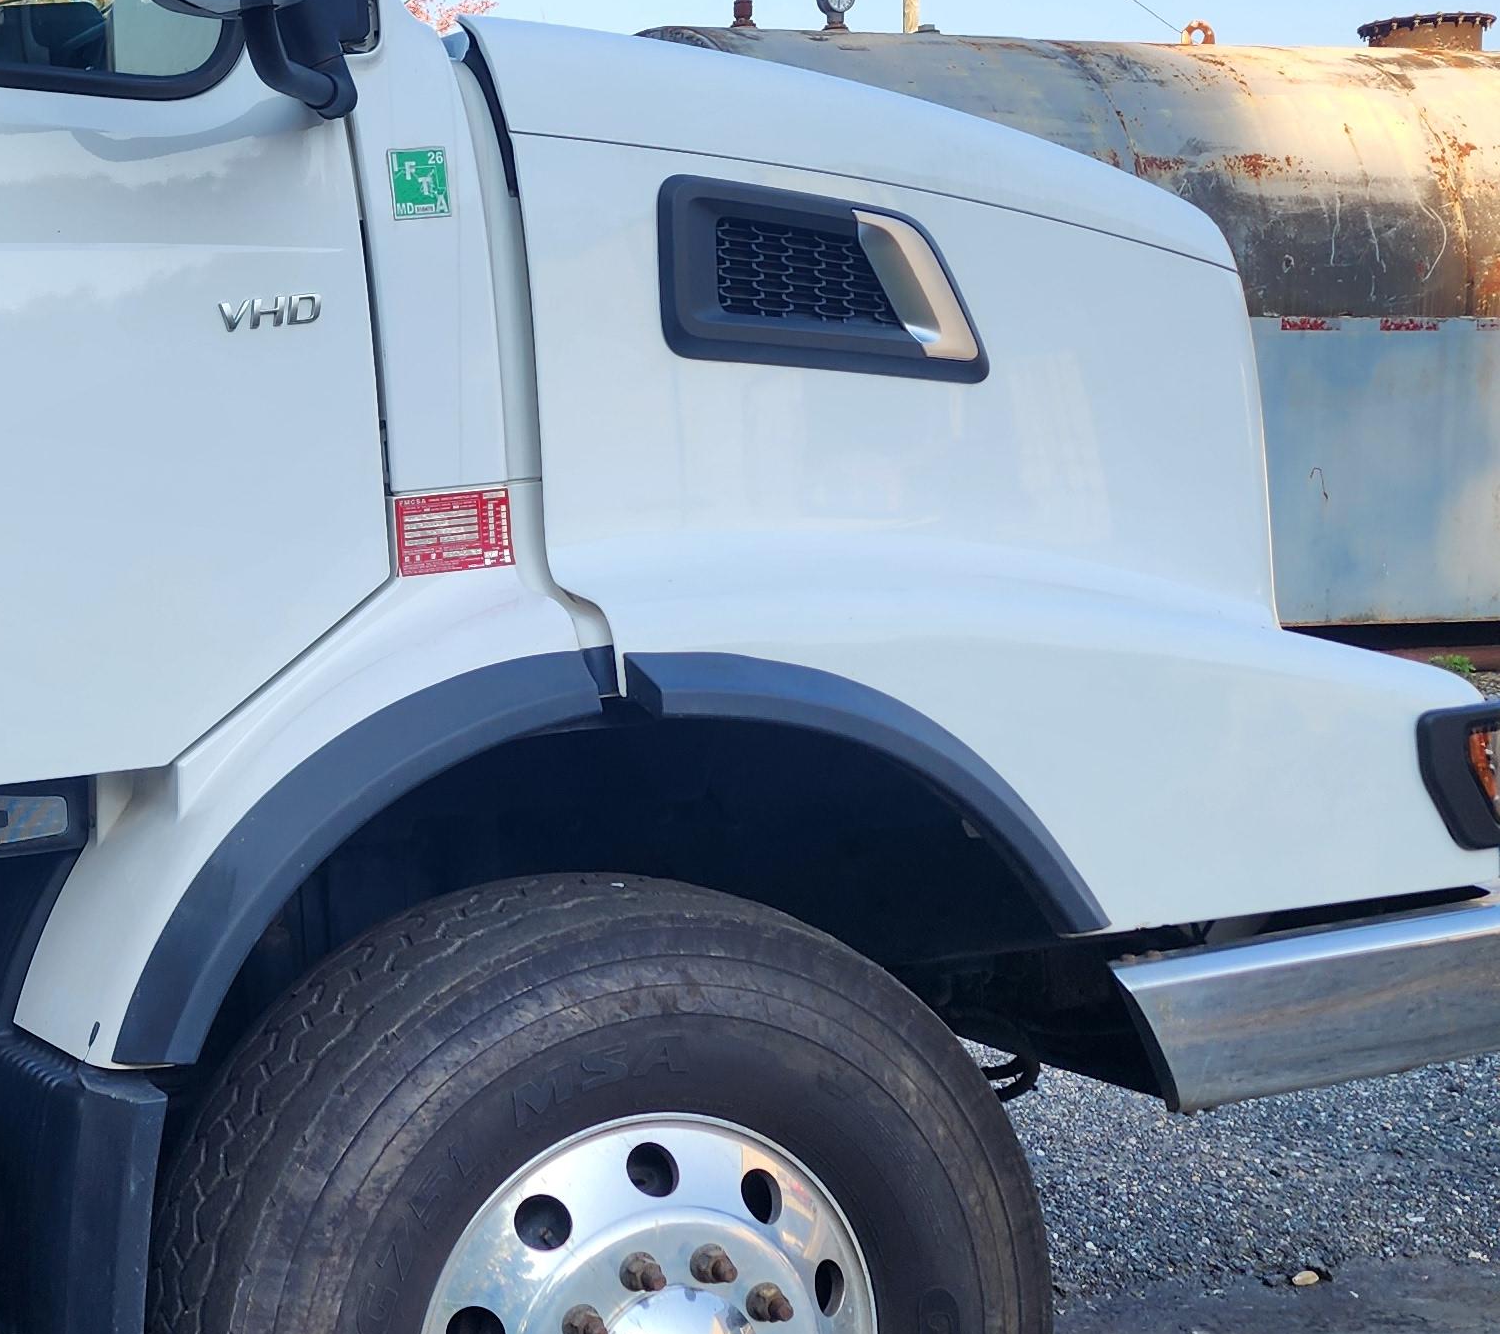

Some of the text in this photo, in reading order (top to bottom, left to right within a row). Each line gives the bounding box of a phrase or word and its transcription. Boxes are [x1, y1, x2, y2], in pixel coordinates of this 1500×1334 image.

[427, 151, 444, 165] 26
[396, 202, 415, 216] MD
[217, 292, 322, 333] VHD
[510, 1031, 692, 1130] MSA
